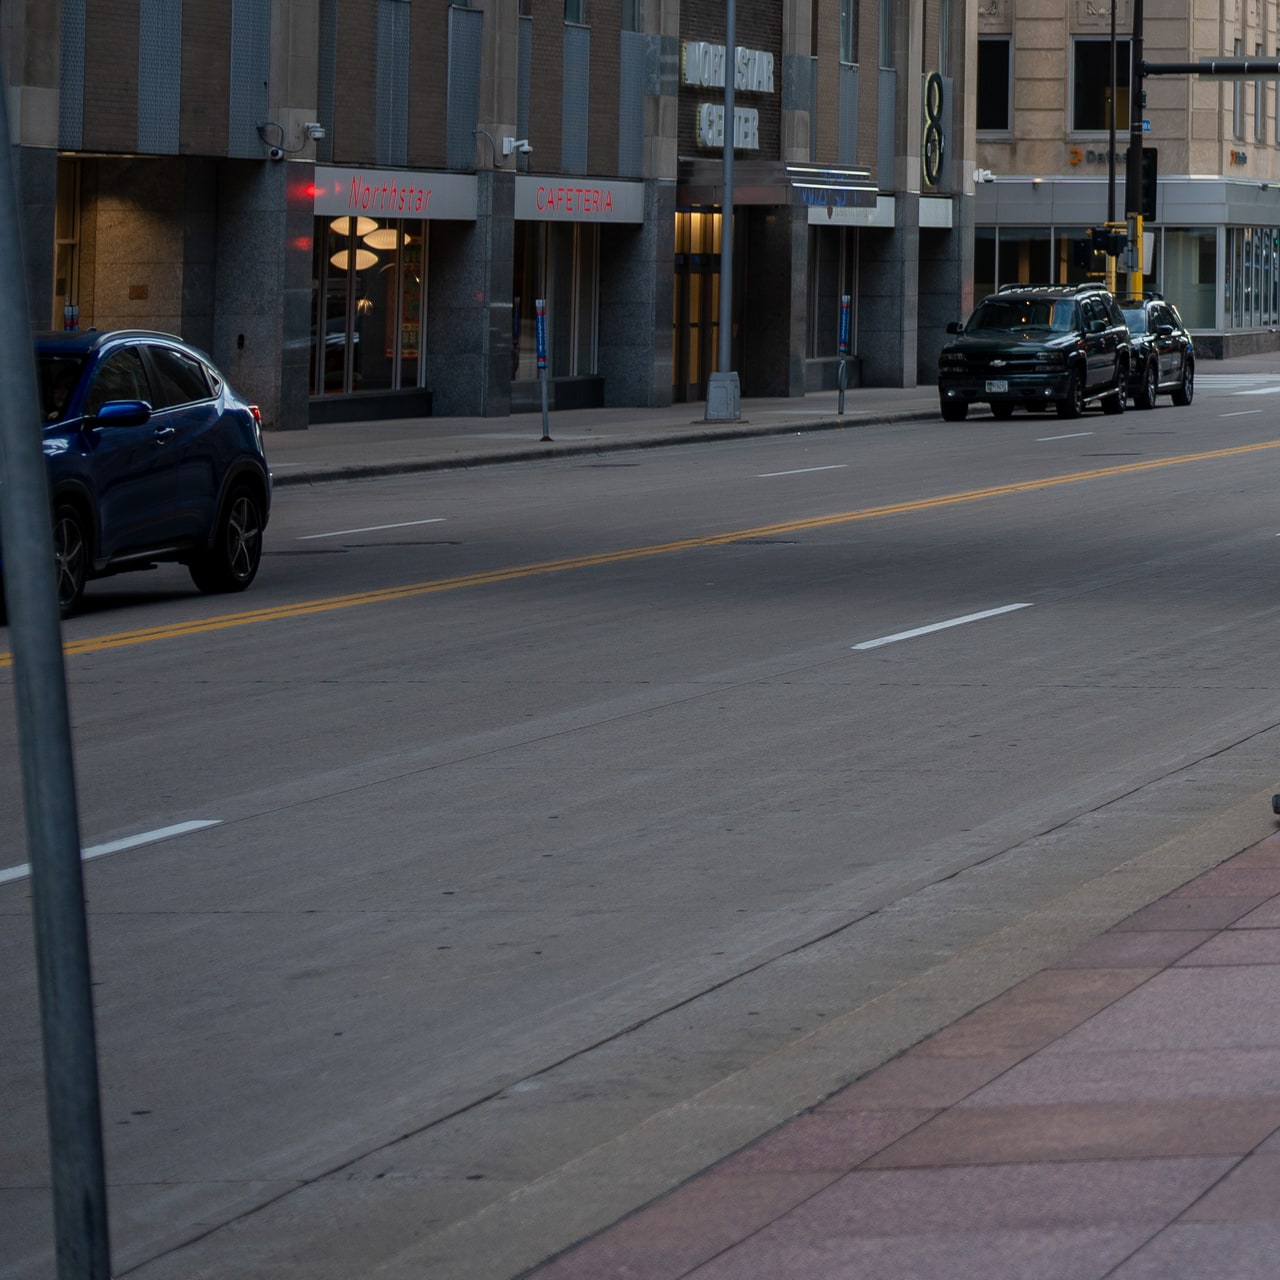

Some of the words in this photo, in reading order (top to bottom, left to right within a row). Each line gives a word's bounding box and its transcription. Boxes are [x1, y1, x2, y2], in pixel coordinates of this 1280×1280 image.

[697, 102, 760, 150] CETER
[348, 176, 432, 212] Northstar
[535, 187, 613, 213] CAFETERIA
